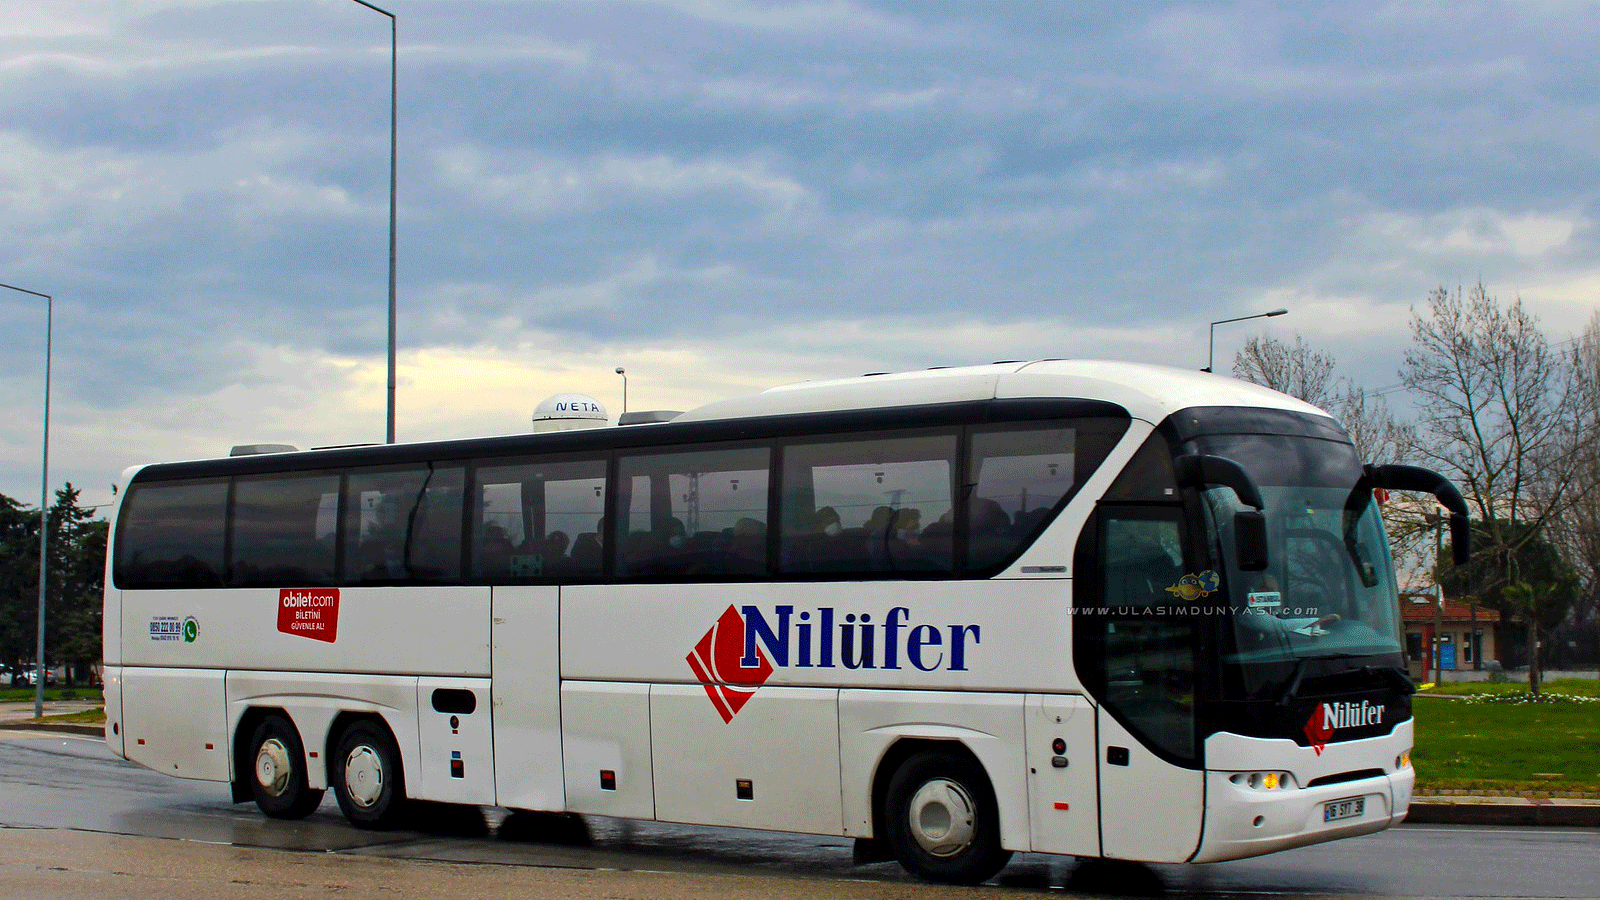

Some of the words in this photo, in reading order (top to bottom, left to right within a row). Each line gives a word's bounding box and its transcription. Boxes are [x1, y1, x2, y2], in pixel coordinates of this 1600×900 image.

[556, 402, 600, 412] NETA
[283, 591, 334, 608] obilet.com
[295, 609, 321, 620] BİLETİNİ
[290, 621, 315, 631] GÜVENLE
[739, 605, 981, 672] Nilüfer
[1322, 699, 1385, 730] Nilüfer
